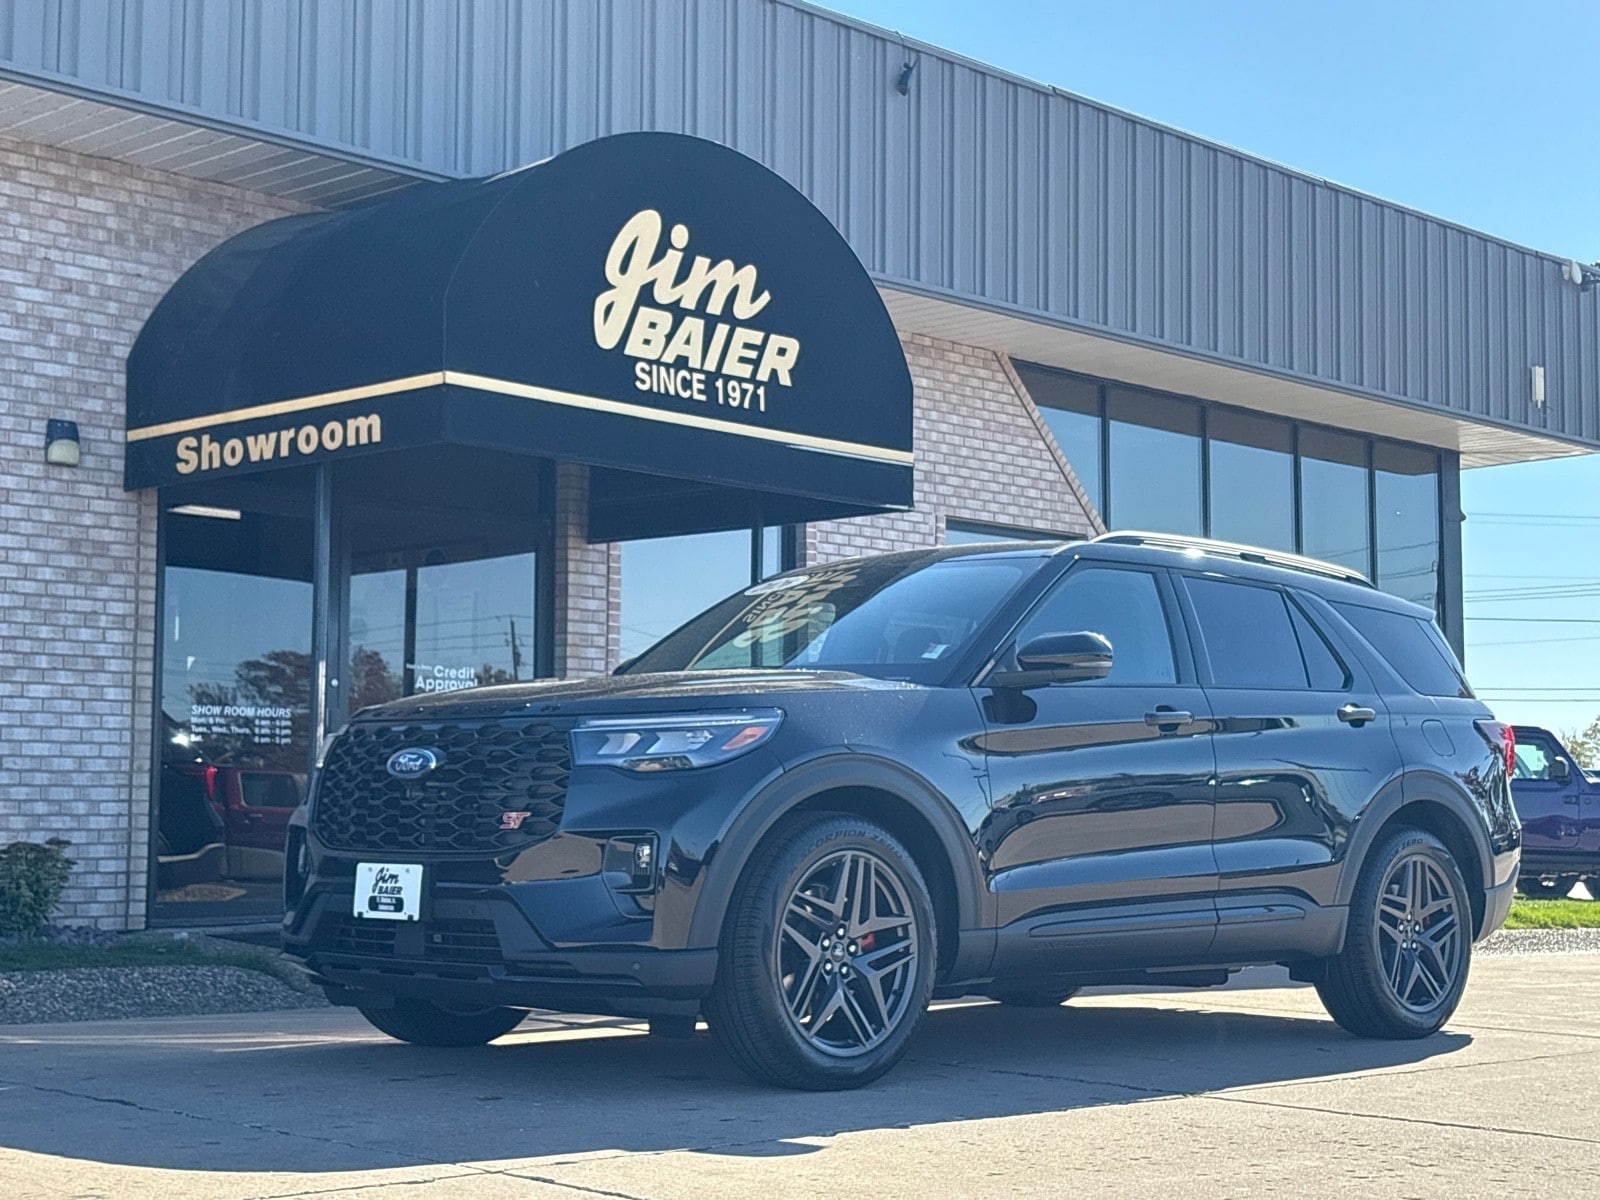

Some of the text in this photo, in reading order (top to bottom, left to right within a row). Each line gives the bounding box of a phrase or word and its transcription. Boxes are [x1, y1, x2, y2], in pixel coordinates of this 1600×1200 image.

[594, 209, 771, 349] Jim
[623, 306, 800, 387] BAIER
[634, 361, 766, 412] SINCE 1971
[176, 413, 382, 475] Showroom
[433, 665, 476, 679] Credit
[414, 675, 479, 693] Approval
[191, 704, 292, 718] SHOW ROOM HOURS
[395, 753, 424, 771] Ford
[500, 811, 532, 829] ST
[371, 866, 400, 895] Jim
[377, 885, 404, 896] BAIER
